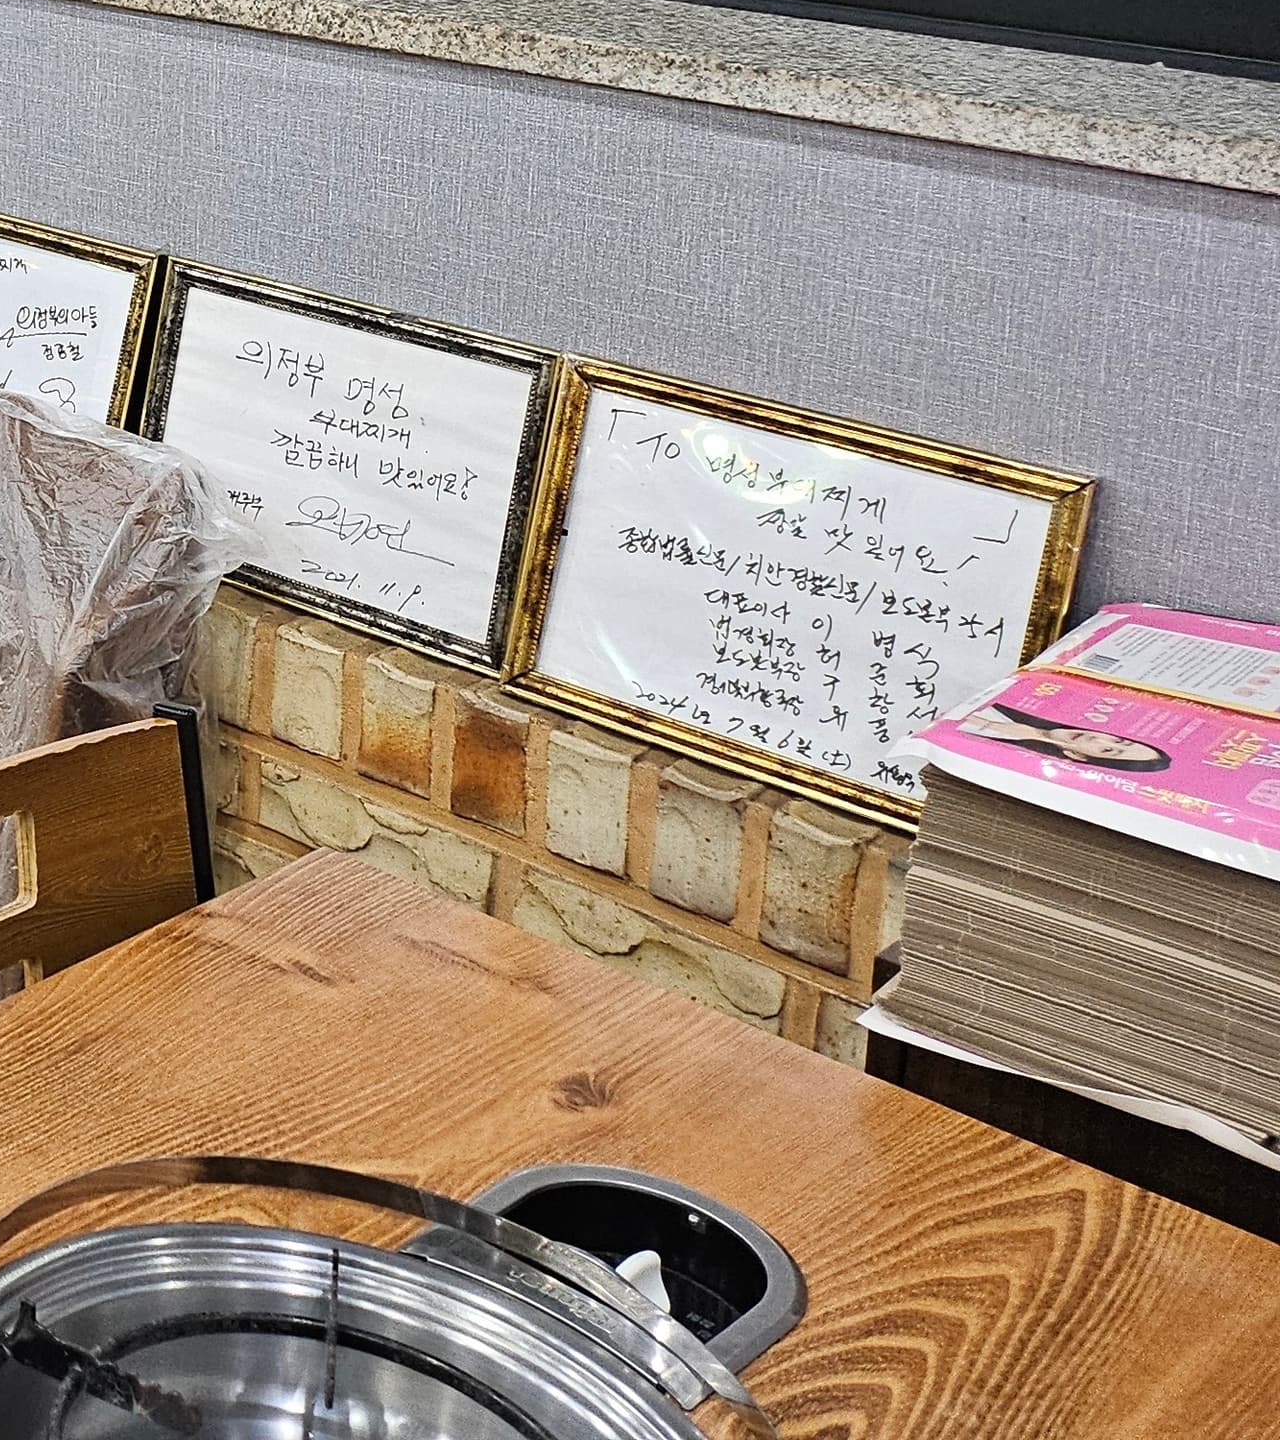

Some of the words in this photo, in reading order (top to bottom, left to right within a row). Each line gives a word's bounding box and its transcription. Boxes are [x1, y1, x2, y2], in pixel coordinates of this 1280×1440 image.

[70, 305, 98, 329] 아들
[235, 340, 326, 399] 의정부
[343, 375, 410, 419] 명성
[309, 408, 412, 451] 부대찌개
[269, 428, 360, 478] 깔끔하니
